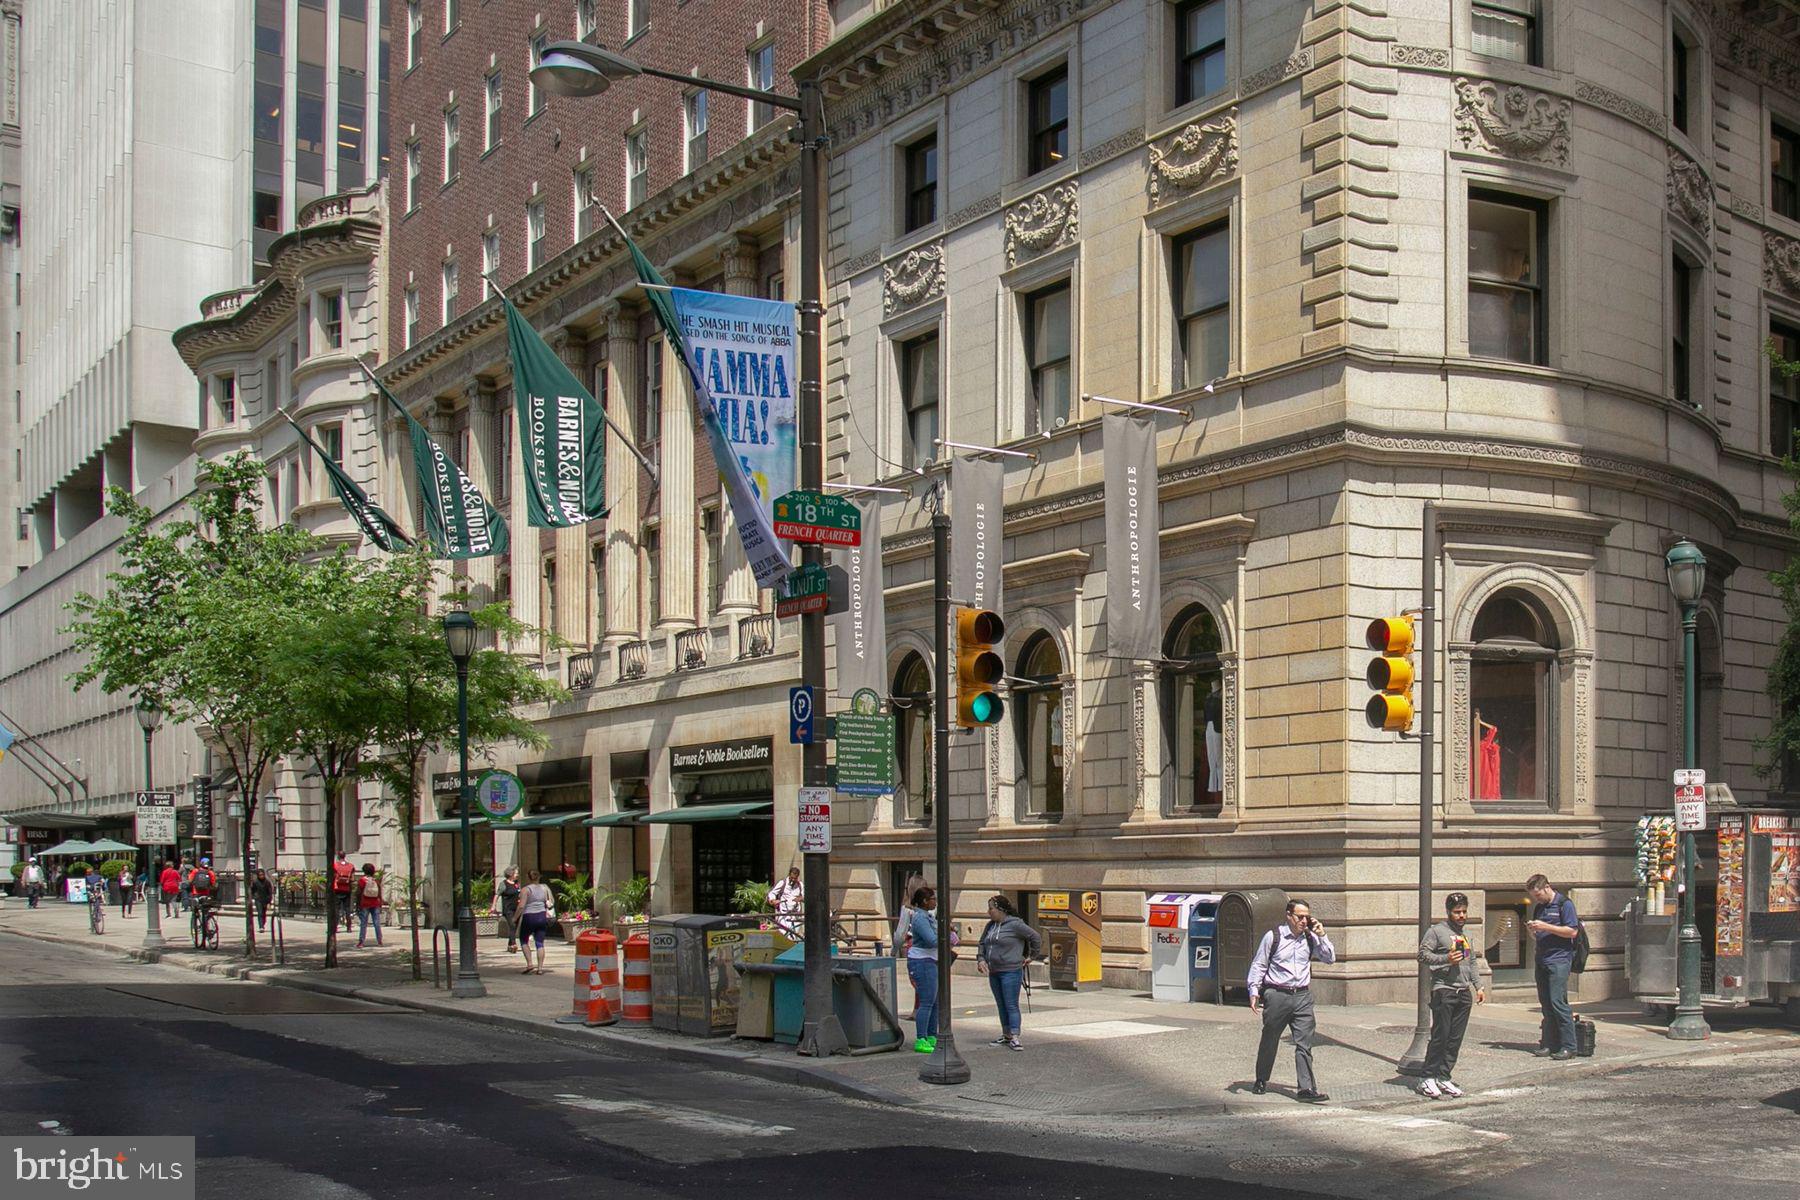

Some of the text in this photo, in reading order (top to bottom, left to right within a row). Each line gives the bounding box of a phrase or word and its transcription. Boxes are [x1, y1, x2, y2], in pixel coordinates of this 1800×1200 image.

[699, 316, 730, 331] SMASH
[734, 320, 749, 333] HIT
[753, 322, 792, 337] MUSICAL
[685, 329, 792, 346] SED ON THE SONGS OF ABBA
[533, 397, 559, 523] BOOKSELLERS
[795, 493, 838, 506] 200 S 100
[841, 514, 857, 528] ST
[778, 524, 853, 543] FRENCH QUARTER
[1128, 466, 1141, 611] ANTHROPOLOGIE
[976, 502, 985, 610] THROPOLOGIE
[818, 578, 826, 593] ST
[780, 598, 823, 614] FRENCH QUARTER
[852, 549, 864, 659] ANTHROPOLOGI
[673, 745, 769, 767] Barnes & Noble Booksellers
[1684, 786, 1695, 796] NO
[809, 805, 820, 815] NO
[1759, 815, 1788, 829] BREAKFAST
[1084, 899, 1097, 913] ups
[653, 937, 673, 946] CKO
[711, 934, 737, 944] CKO
[1157, 928, 1180, 940] FedEx
